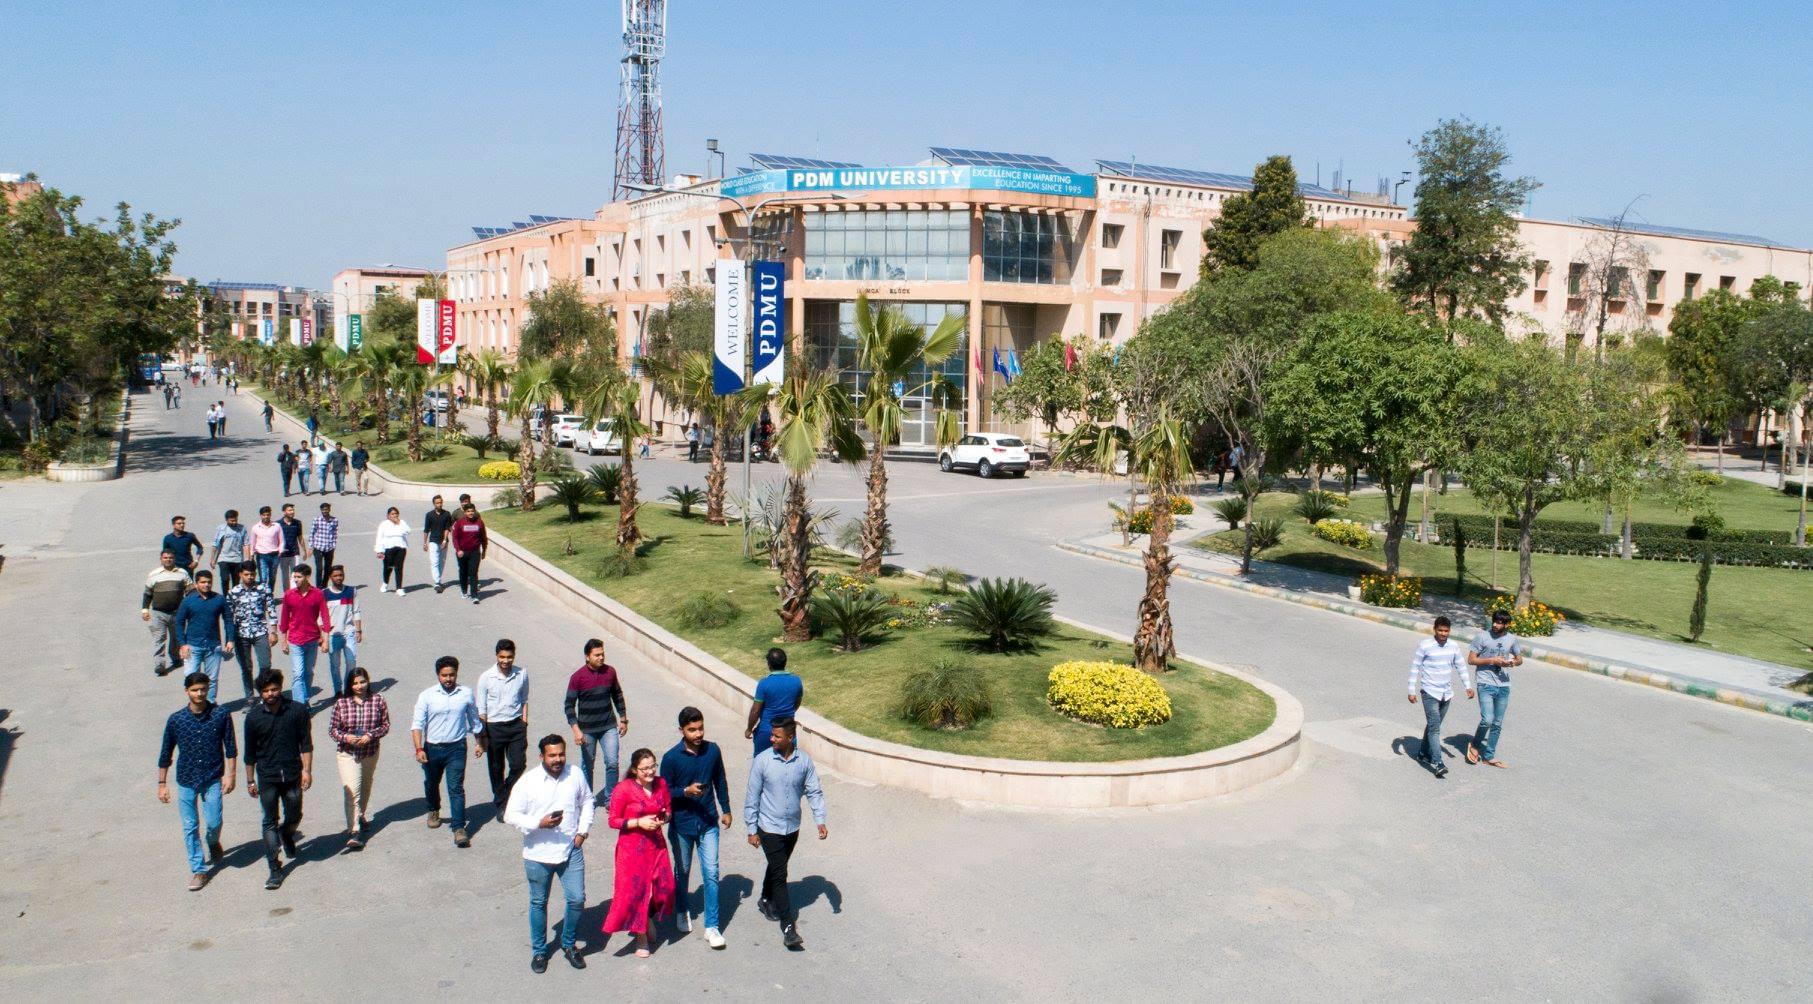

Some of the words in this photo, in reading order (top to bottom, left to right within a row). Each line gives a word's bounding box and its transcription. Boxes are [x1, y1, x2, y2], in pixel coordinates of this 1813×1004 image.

[793, 172, 833, 187] PDM
[840, 169, 963, 186] UNIVERSITY
[972, 169, 1020, 179] EXCELLENCE
[1022, 172, 1031, 181] IN
[1033, 173, 1071, 184] IMPARTING
[995, 179, 1039, 190] EDUCATION
[1041, 183, 1062, 192] SINCE
[1065, 185, 1082, 194] 1995
[442, 304, 453, 345] PDMU
[727, 269, 739, 356] WELCOME
[760, 272, 778, 356] PDMU
[352, 317, 360, 345] PDMU
